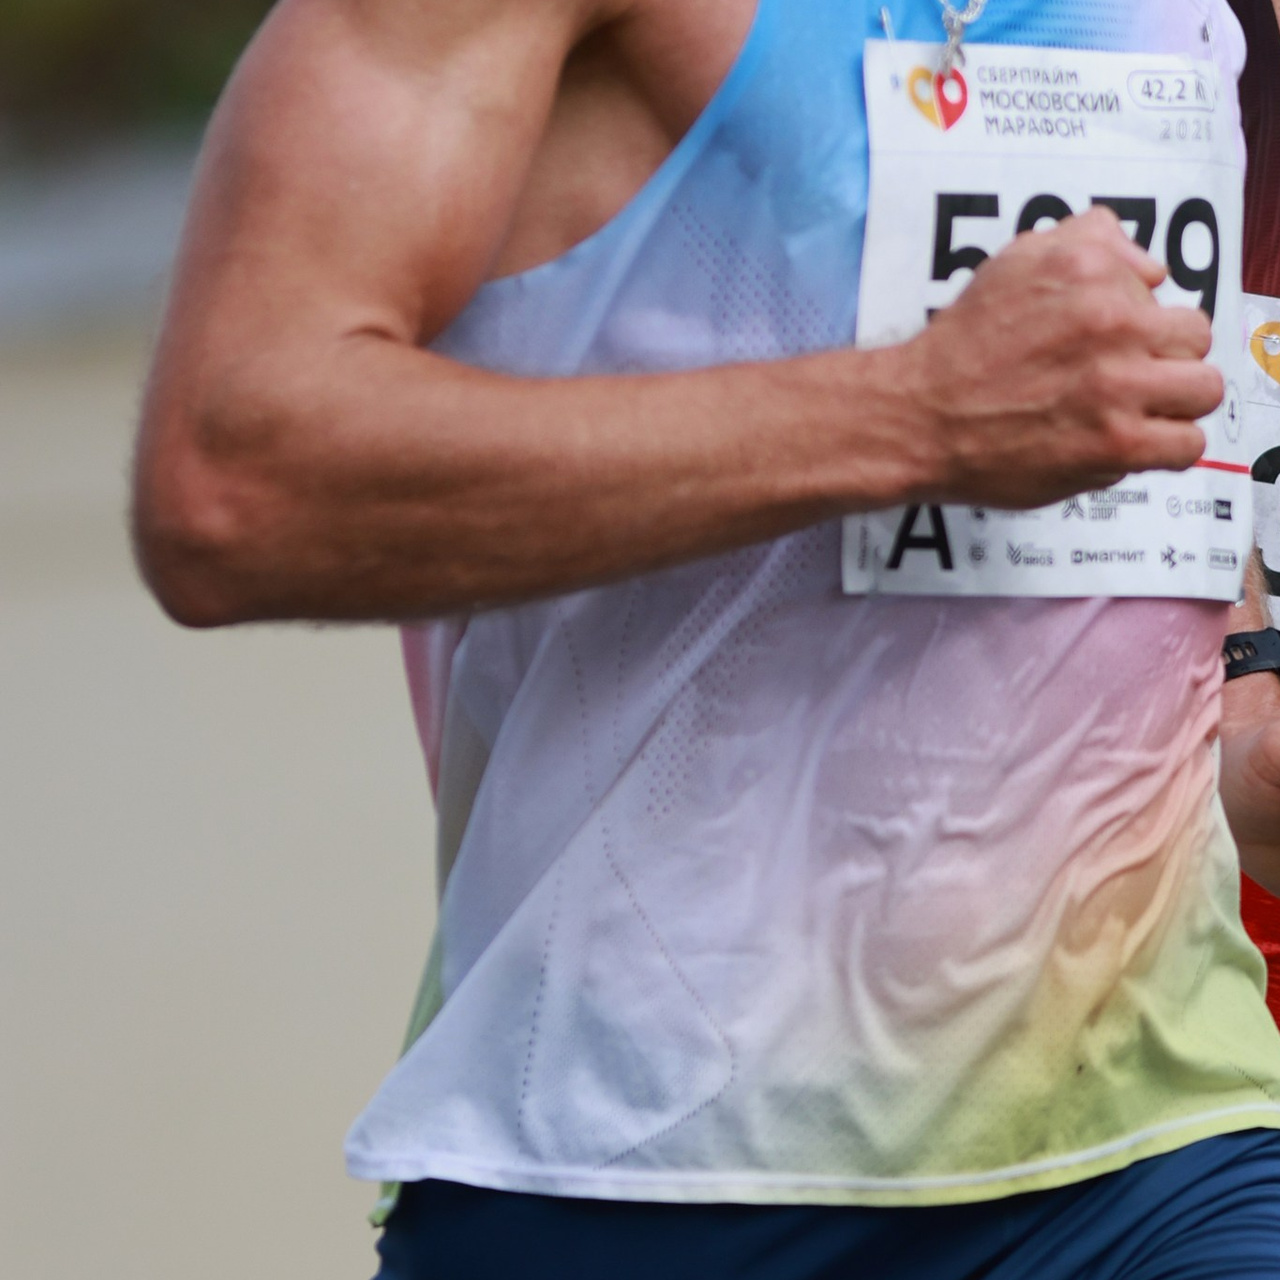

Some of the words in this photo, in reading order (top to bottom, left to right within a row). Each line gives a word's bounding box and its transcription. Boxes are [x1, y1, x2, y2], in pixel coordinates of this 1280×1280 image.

[977, 65, 1078, 86] СБЕРПРАЙМ
[980, 88, 1120, 112] МОСКОВСКИЙ
[1141, 78, 1186, 103] 42,2
[985, 116, 1086, 138] МАРАФОН
[926, 193, 1219, 325] 579
